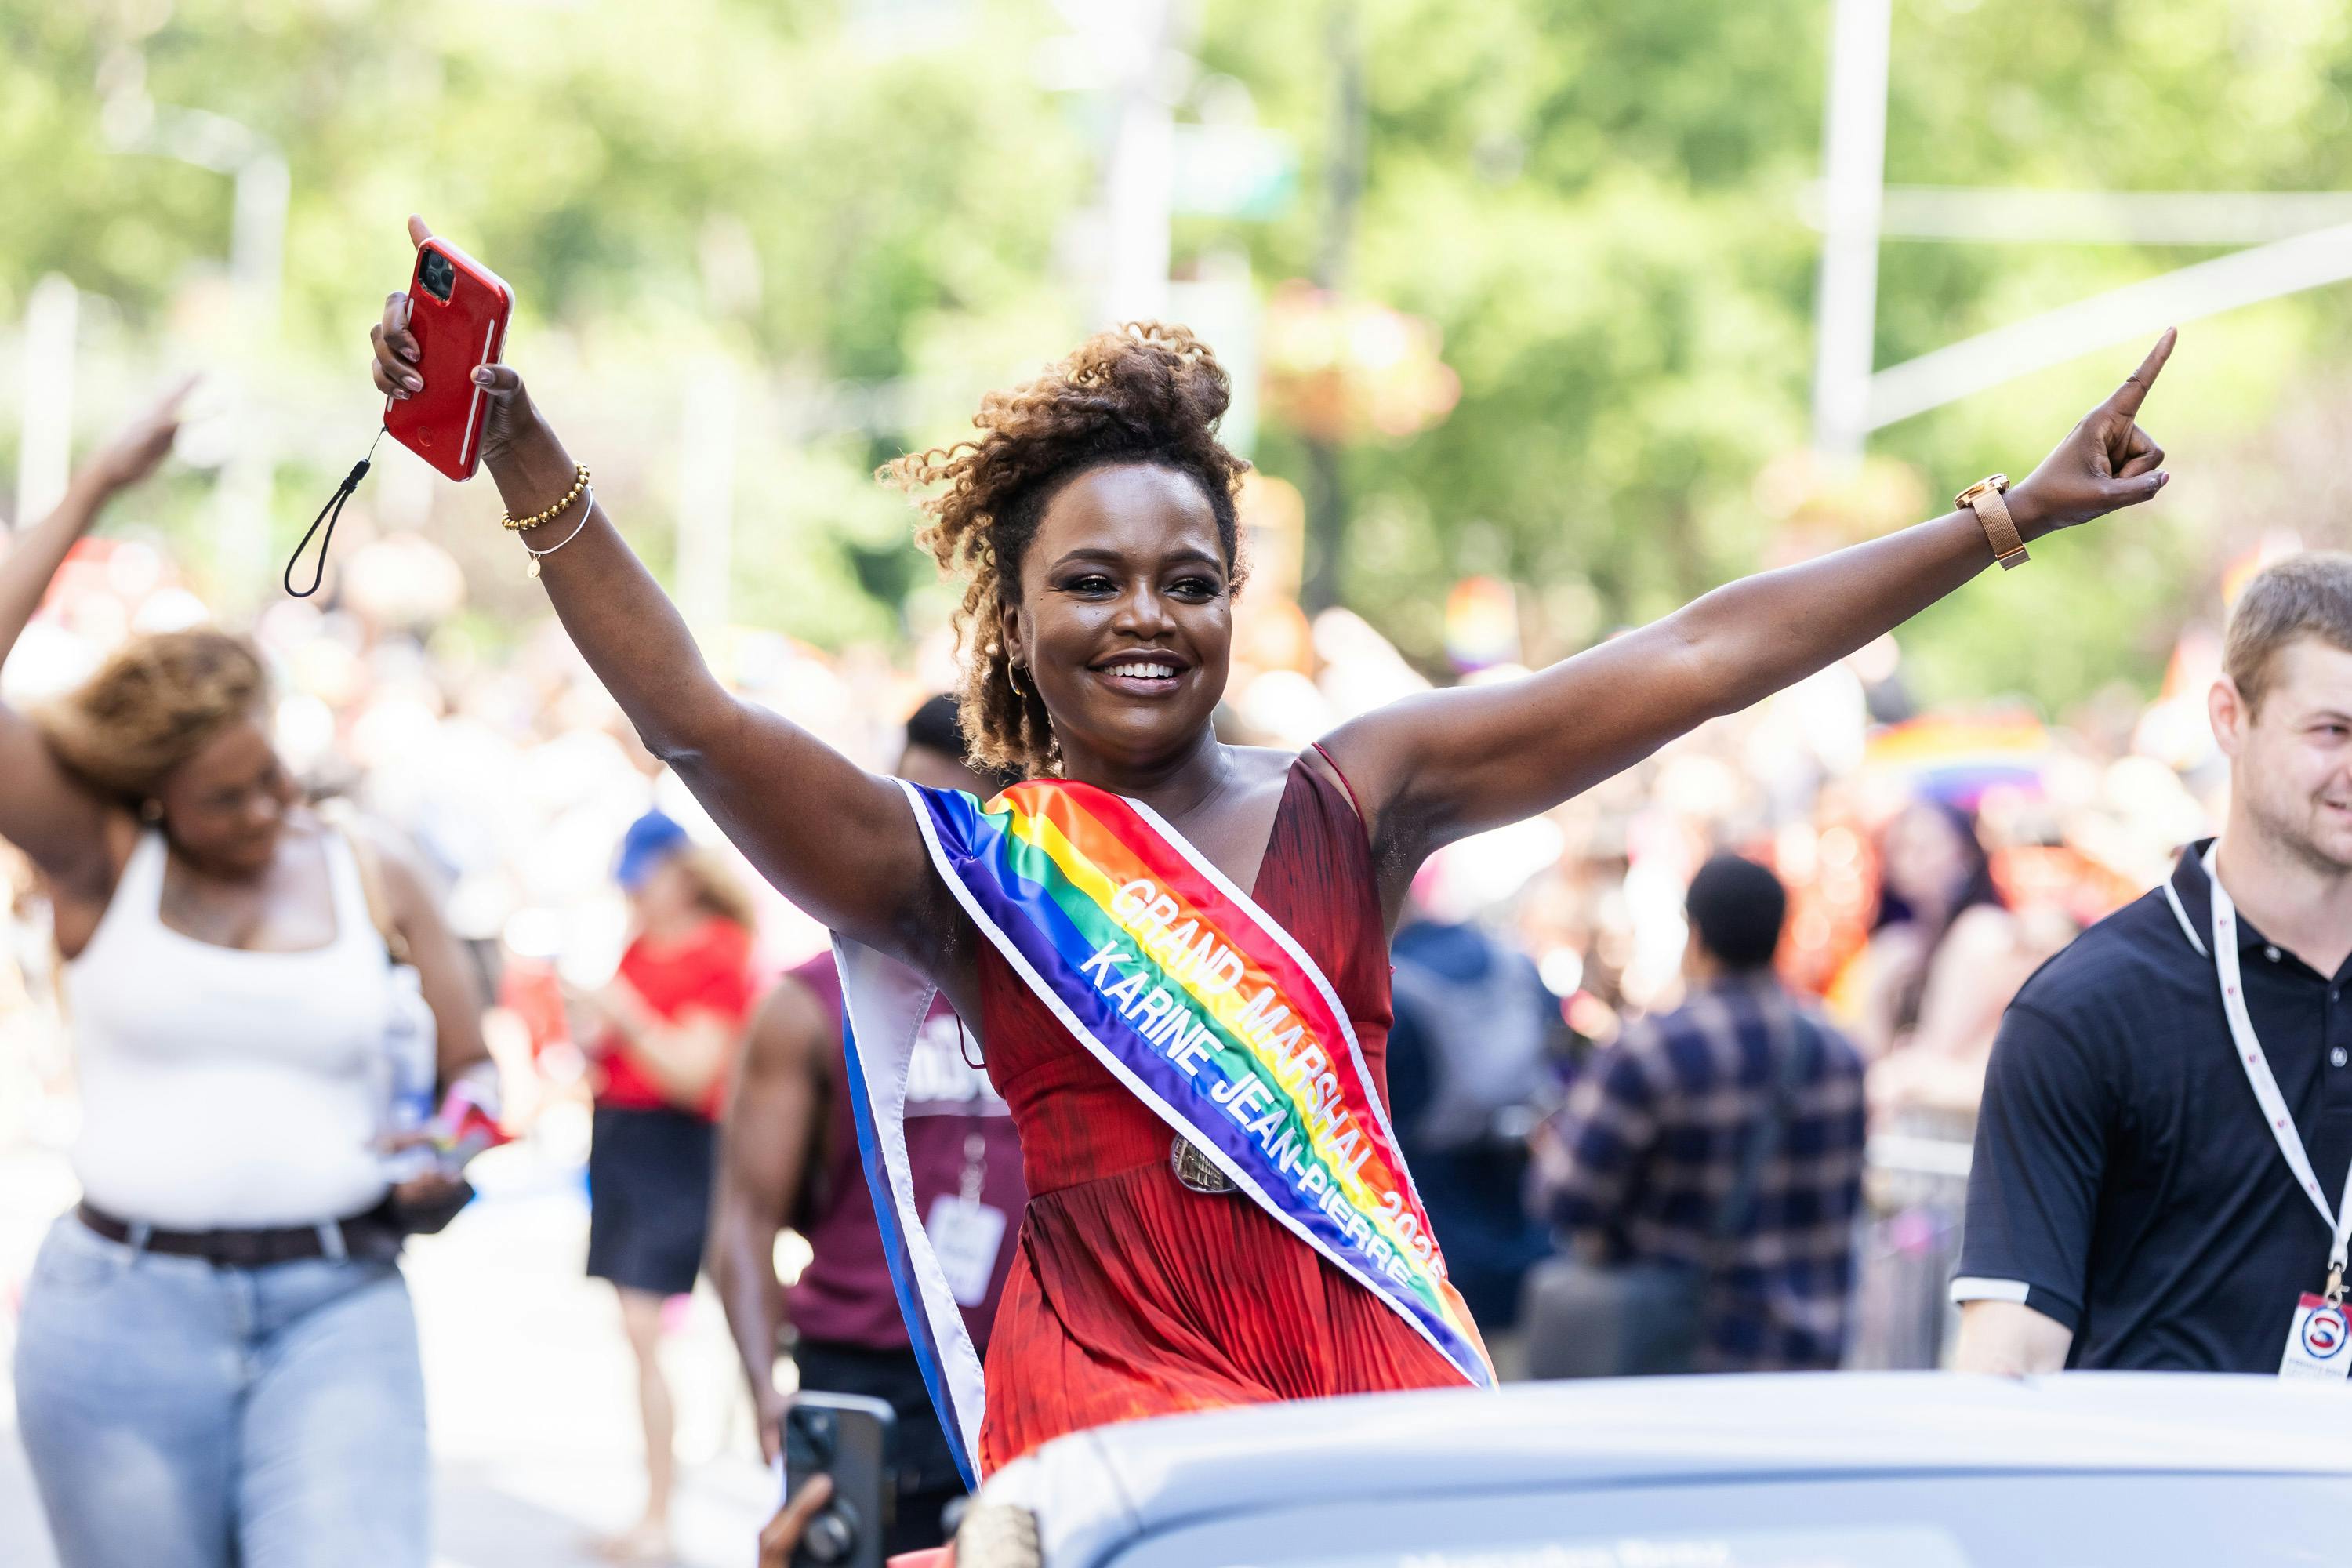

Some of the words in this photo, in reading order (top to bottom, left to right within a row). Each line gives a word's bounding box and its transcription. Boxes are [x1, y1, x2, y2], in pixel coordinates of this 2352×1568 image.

[1080, 941, 1225, 1076] KARINE
[1211, 1072, 1412, 1289] JEAN-PIERRE
[1112, 879, 1244, 993] GRAND
[1236, 986, 1371, 1194] MARSHAL
